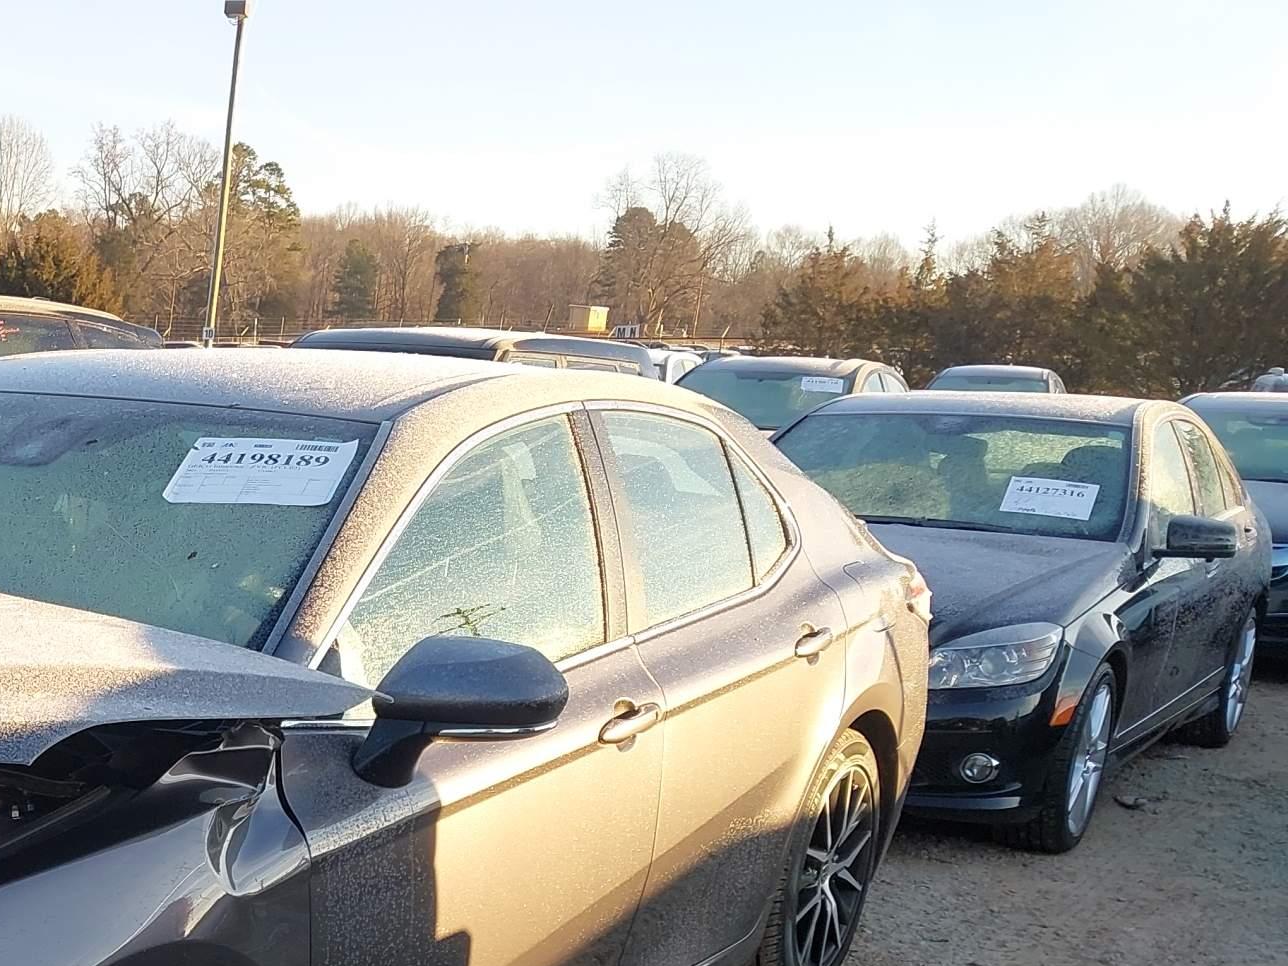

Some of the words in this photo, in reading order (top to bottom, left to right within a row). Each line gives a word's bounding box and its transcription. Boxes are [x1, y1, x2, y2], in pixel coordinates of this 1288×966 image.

[204, 329, 214, 338] 10
[201, 452, 330, 467] 44198189
[1016, 485, 1085, 498] 44127316
